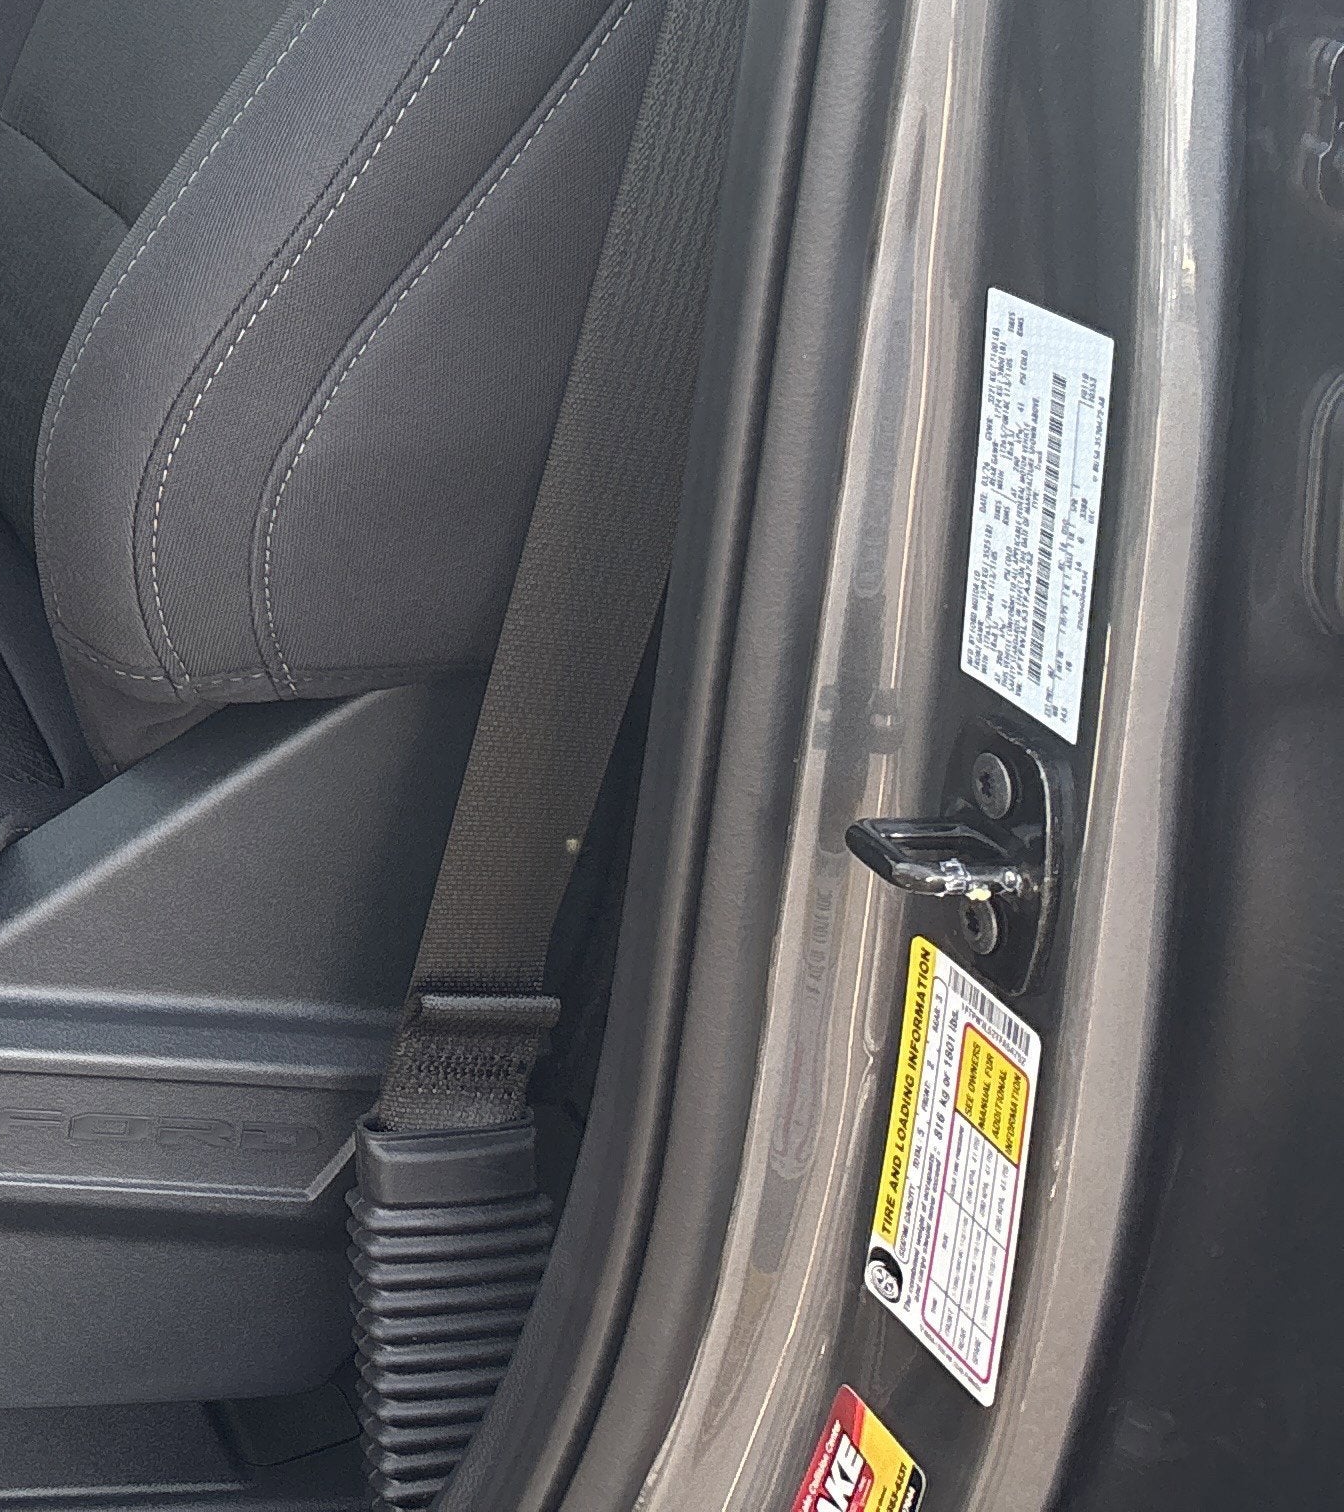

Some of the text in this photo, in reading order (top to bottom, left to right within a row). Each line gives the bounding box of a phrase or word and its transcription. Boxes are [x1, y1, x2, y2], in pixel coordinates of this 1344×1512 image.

[881, 944, 932, 1240] TIRE AND LOADING INFORMATION
[938, 1086, 950, 1110] kg
[941, 1068, 951, 1089] or
[964, 1039, 981, 1118] SEE OWNERS
[977, 1050, 994, 1131] MANUAL FOR
[991, 1066, 1007, 1140] ADDITIONAL
[1004, 1071, 1021, 1156] INFORMATION
[933, 1109, 945, 1142] 816
